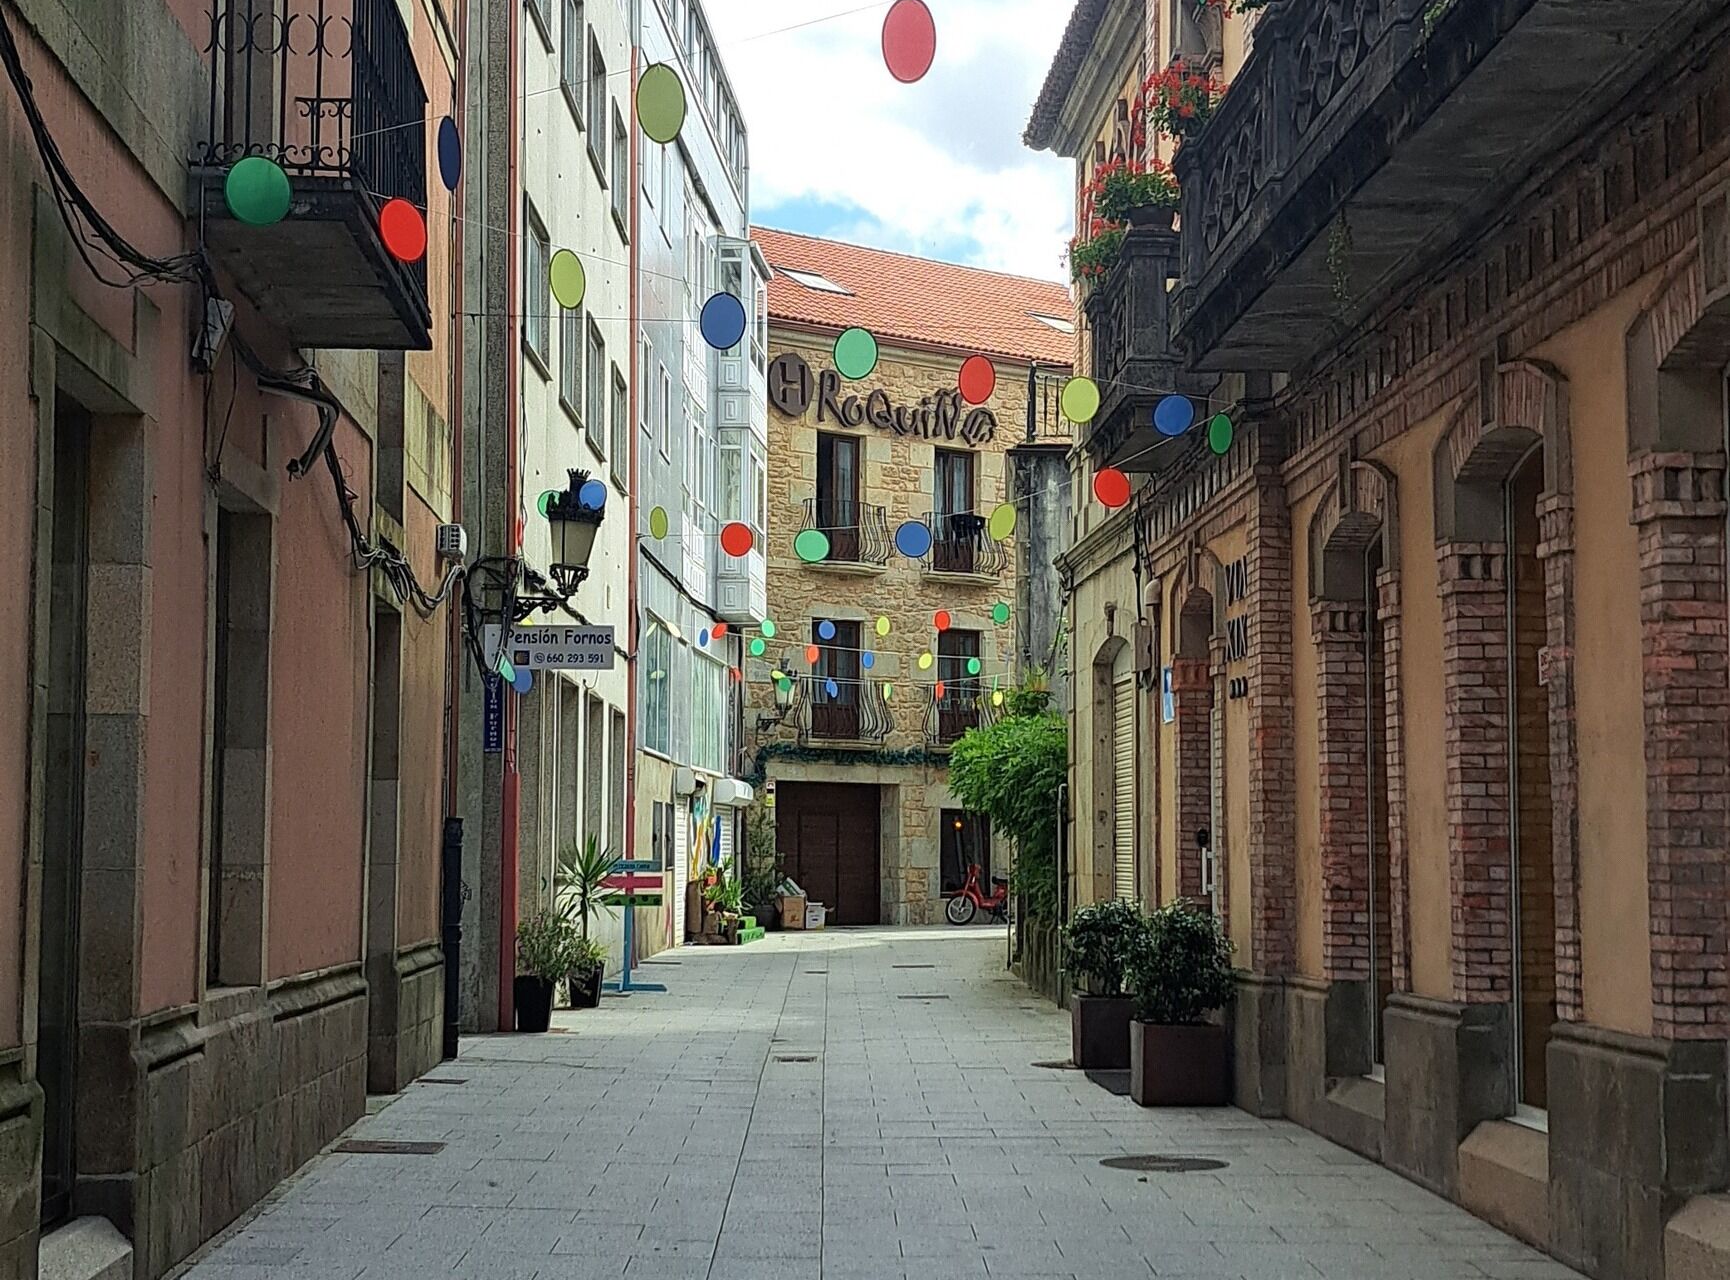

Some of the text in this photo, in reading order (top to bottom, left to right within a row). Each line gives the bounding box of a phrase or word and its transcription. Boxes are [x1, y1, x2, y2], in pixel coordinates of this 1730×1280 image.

[564, 629, 611, 645] Fornos
[567, 652, 584, 664] 293
[588, 653, 604, 664] 591
